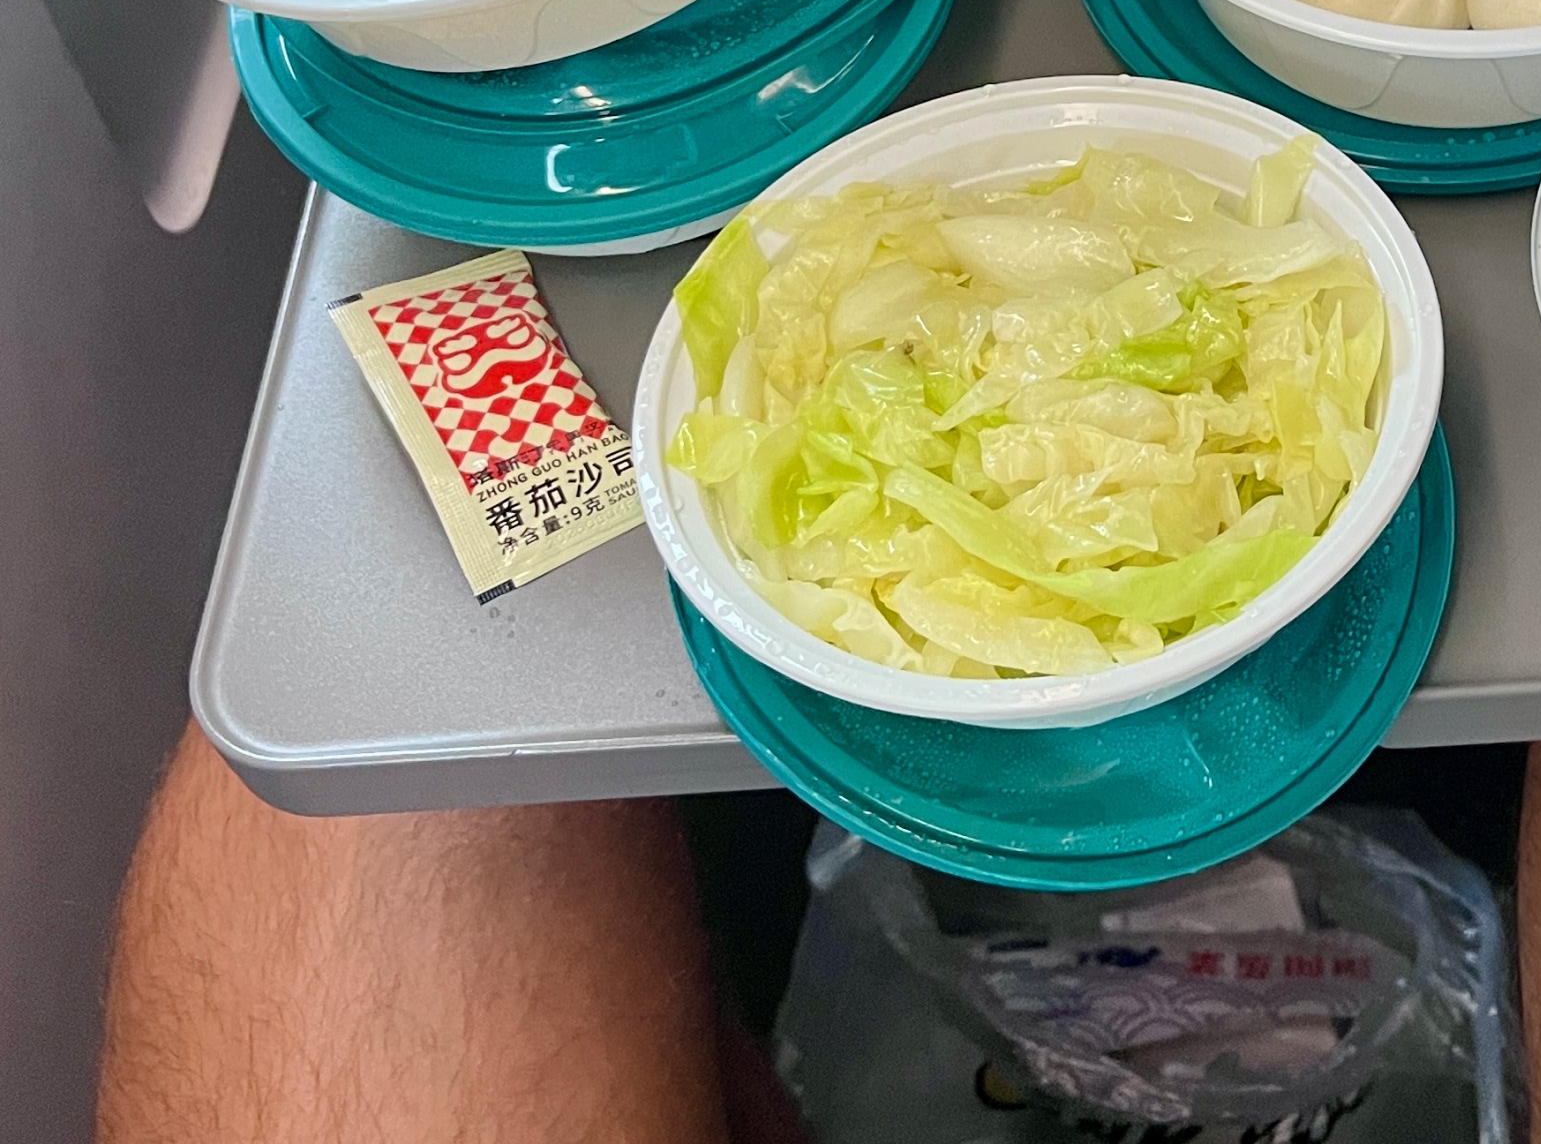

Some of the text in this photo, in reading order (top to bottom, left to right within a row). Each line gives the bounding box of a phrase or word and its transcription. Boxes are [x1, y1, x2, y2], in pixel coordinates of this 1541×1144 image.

[477, 473, 529, 504] ZHONG
[531, 458, 563, 478] GUO
[566, 442, 599, 463] HAN
[485, 446, 634, 537] 番茄沙司
